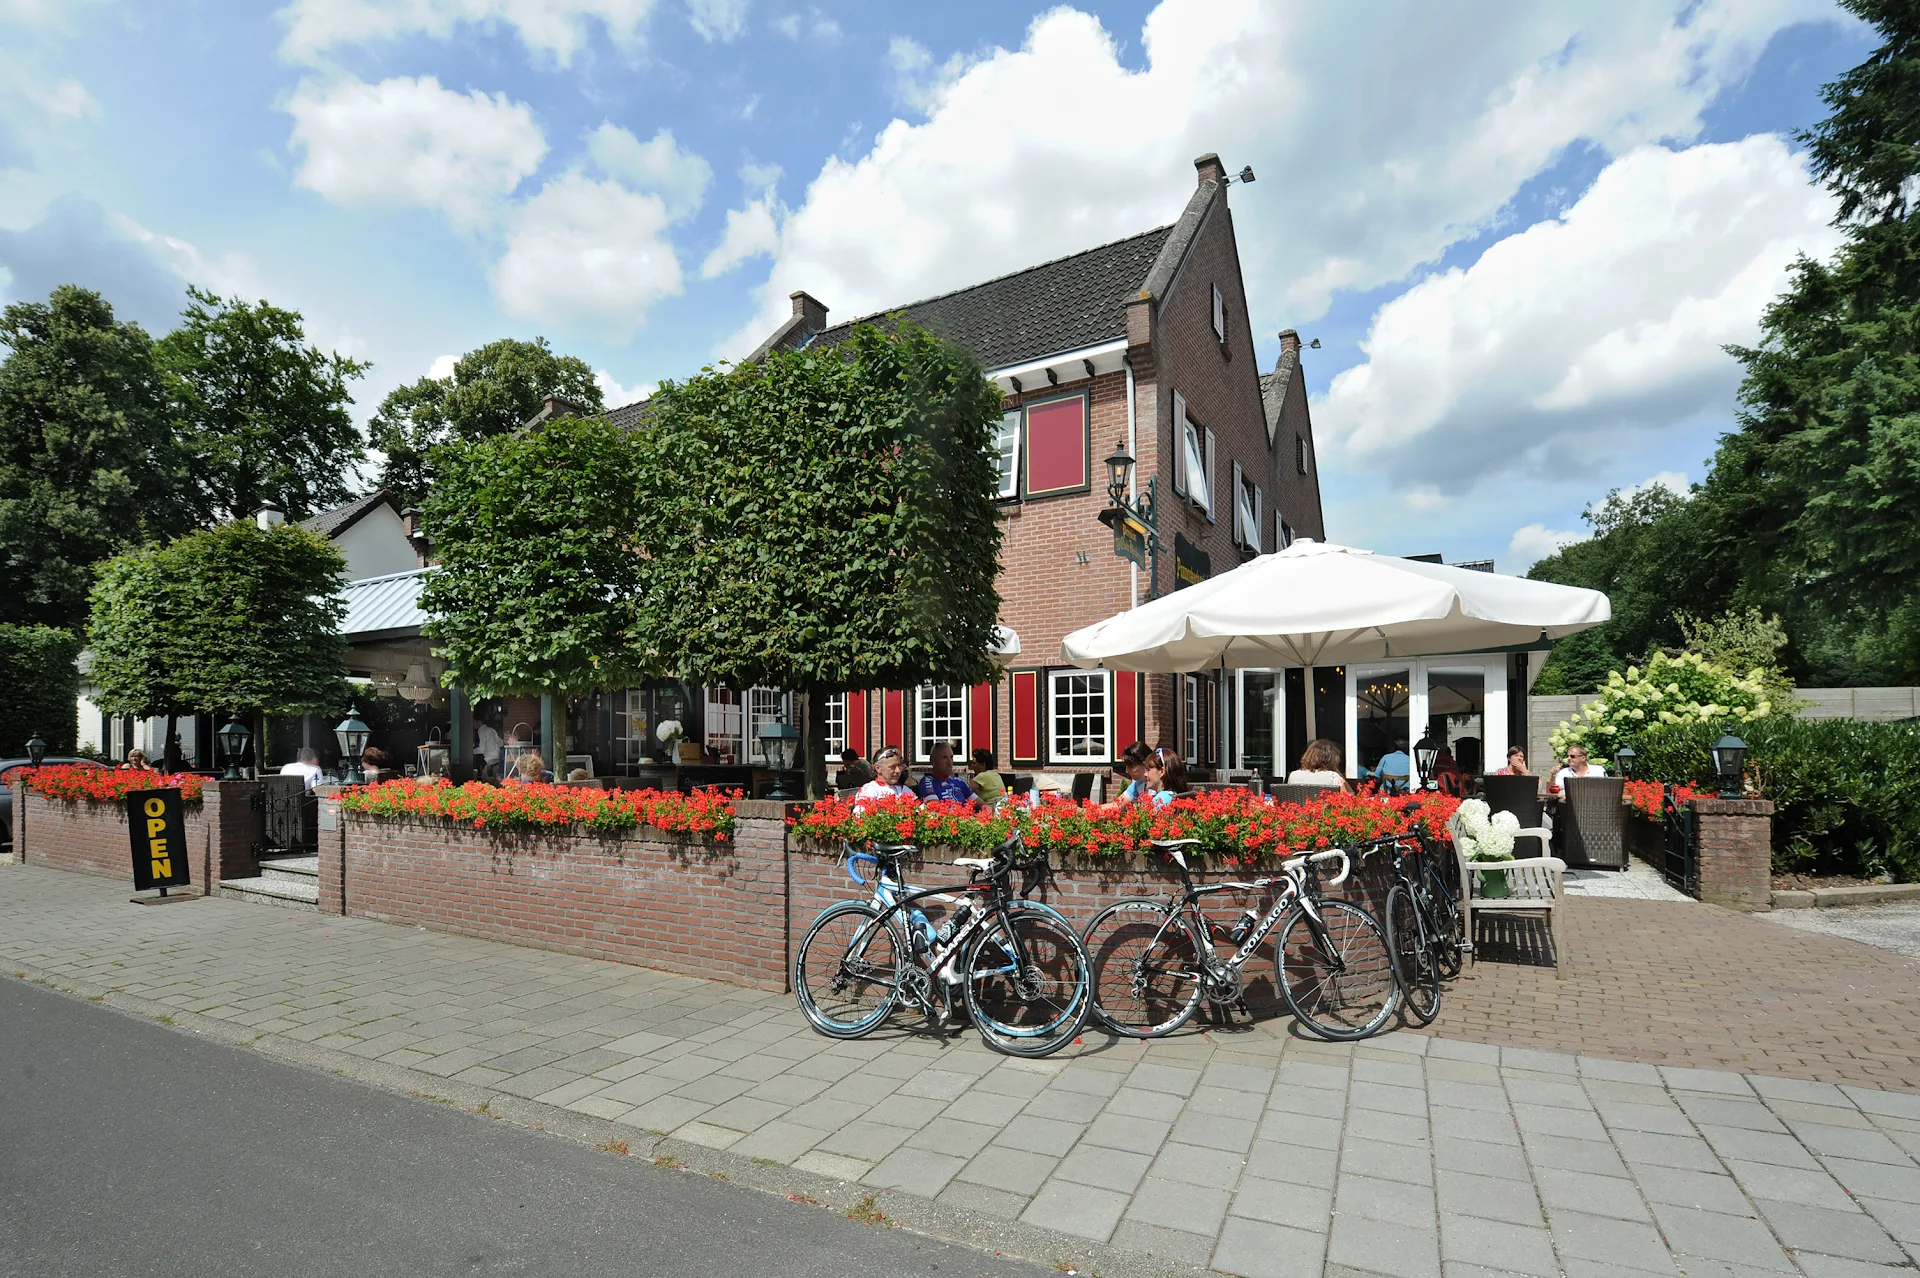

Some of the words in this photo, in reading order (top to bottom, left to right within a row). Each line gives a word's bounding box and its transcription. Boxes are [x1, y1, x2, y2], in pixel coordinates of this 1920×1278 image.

[144, 798, 172, 879] OPEN
[930, 907, 987, 971] PINARELLO
[1241, 899, 1288, 956] COLNAGO
[1365, 1002, 1392, 1029] EASTON
